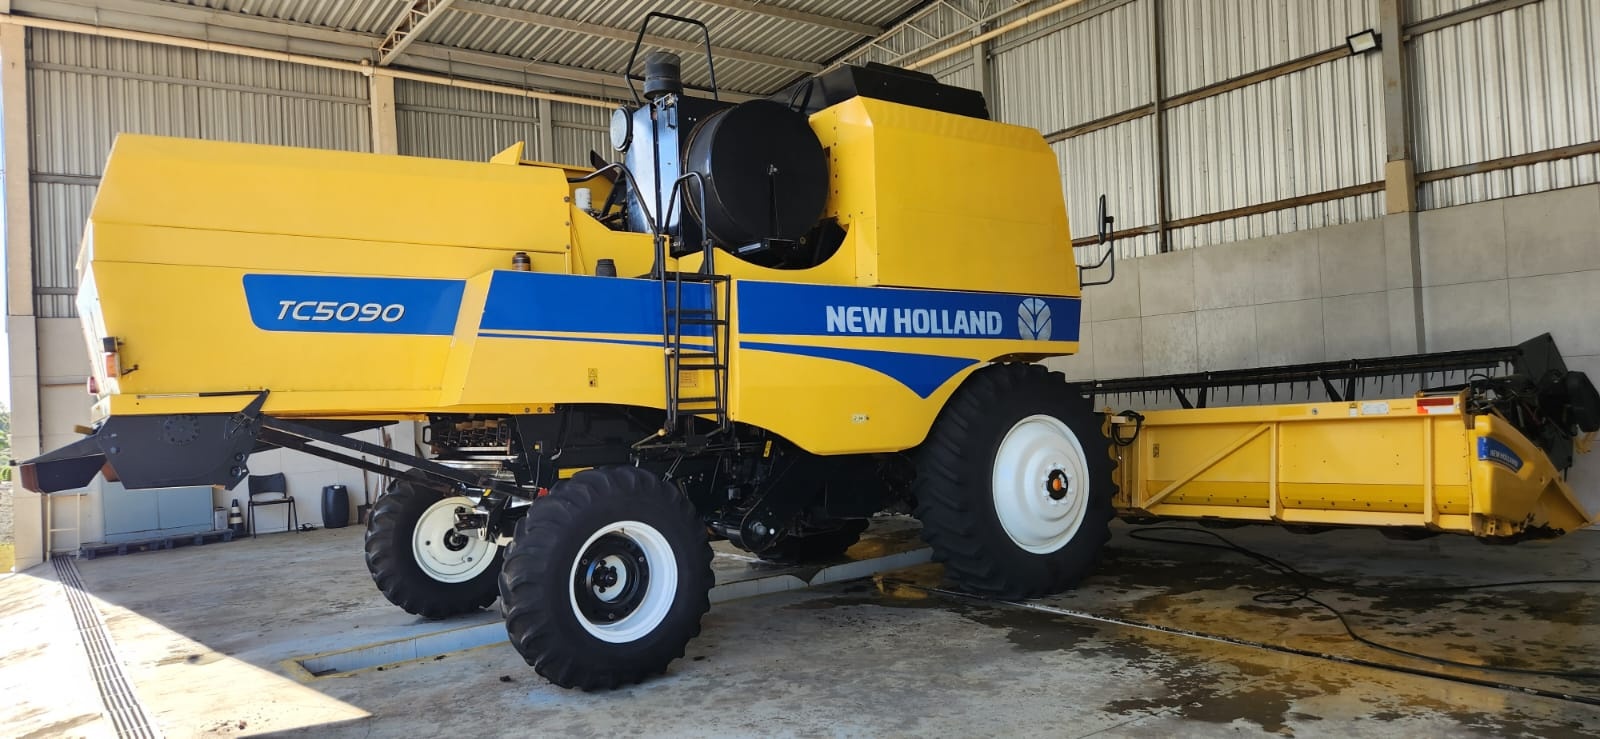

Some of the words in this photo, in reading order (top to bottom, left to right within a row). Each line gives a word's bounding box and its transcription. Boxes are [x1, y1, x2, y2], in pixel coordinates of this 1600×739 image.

[277, 300, 406, 323] TC5090
[826, 305, 888, 334] NEW
[893, 308, 1003, 336] HOLLAND
